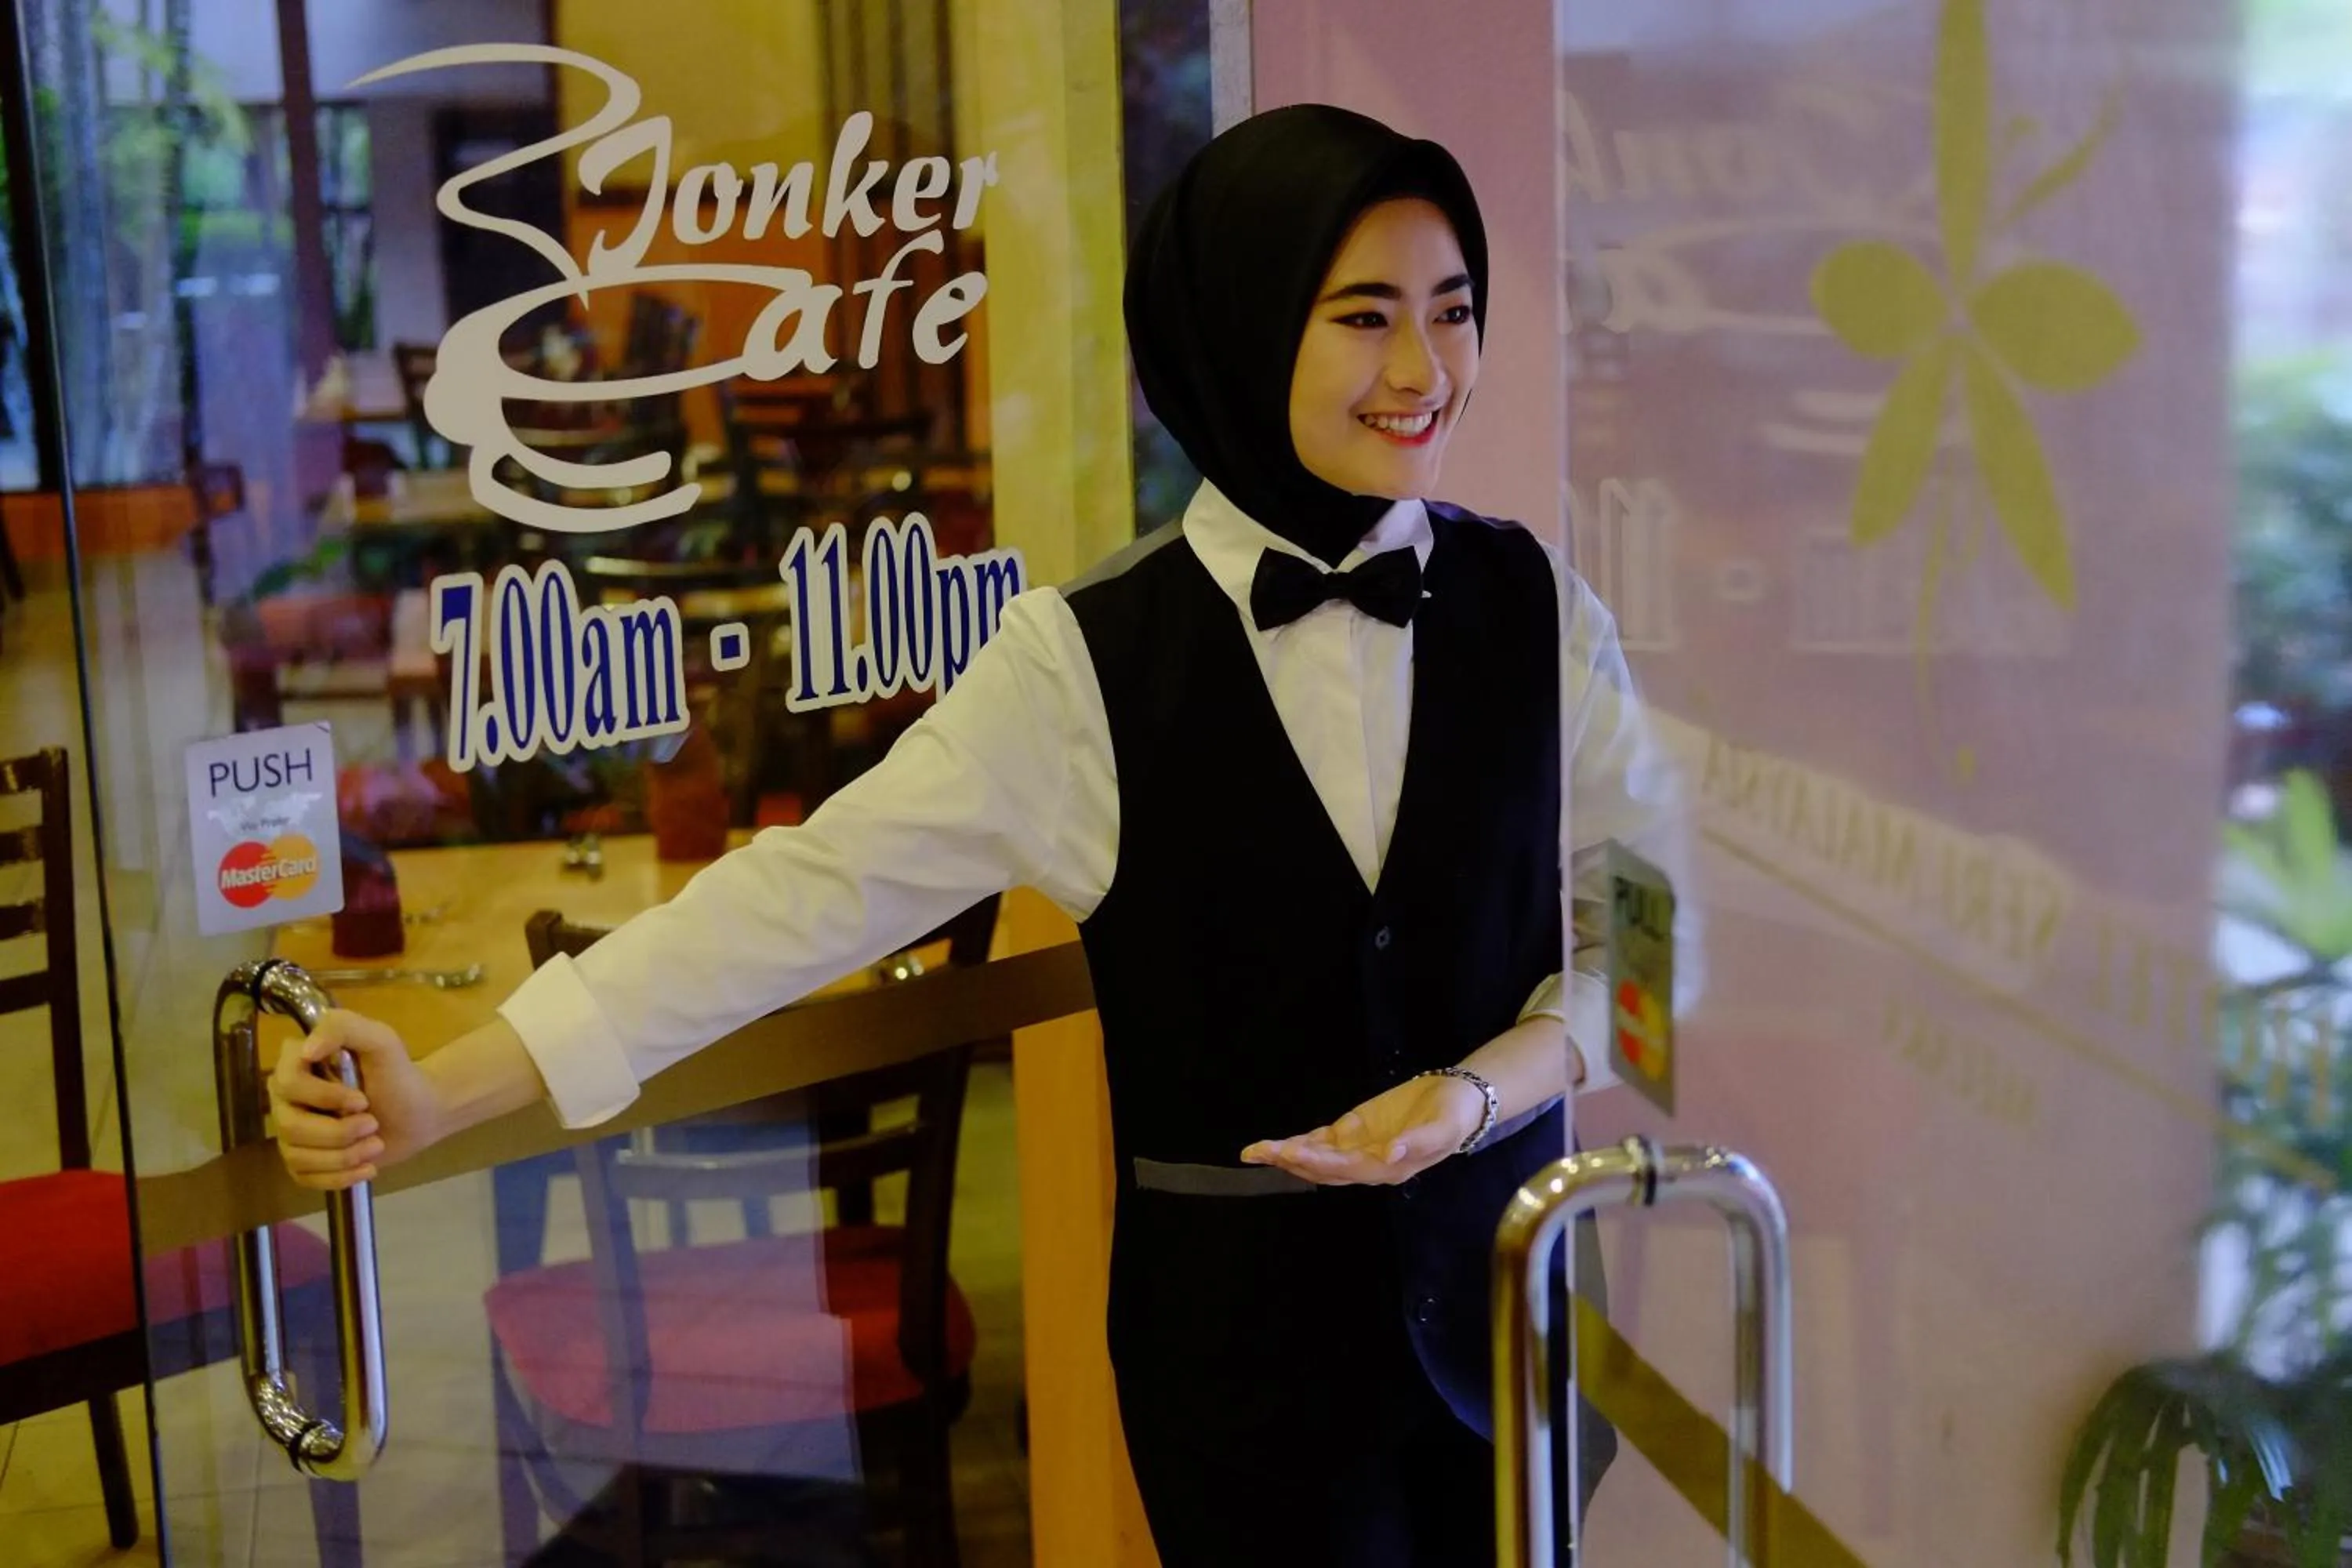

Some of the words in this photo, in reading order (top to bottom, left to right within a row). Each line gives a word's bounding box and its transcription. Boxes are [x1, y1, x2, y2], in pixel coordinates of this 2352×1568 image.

[577, 111, 998, 278] Jonker
[435, 566, 685, 765] 7.00am
[208, 747, 313, 798] PUSH
[220, 857, 318, 890] MasterCard
